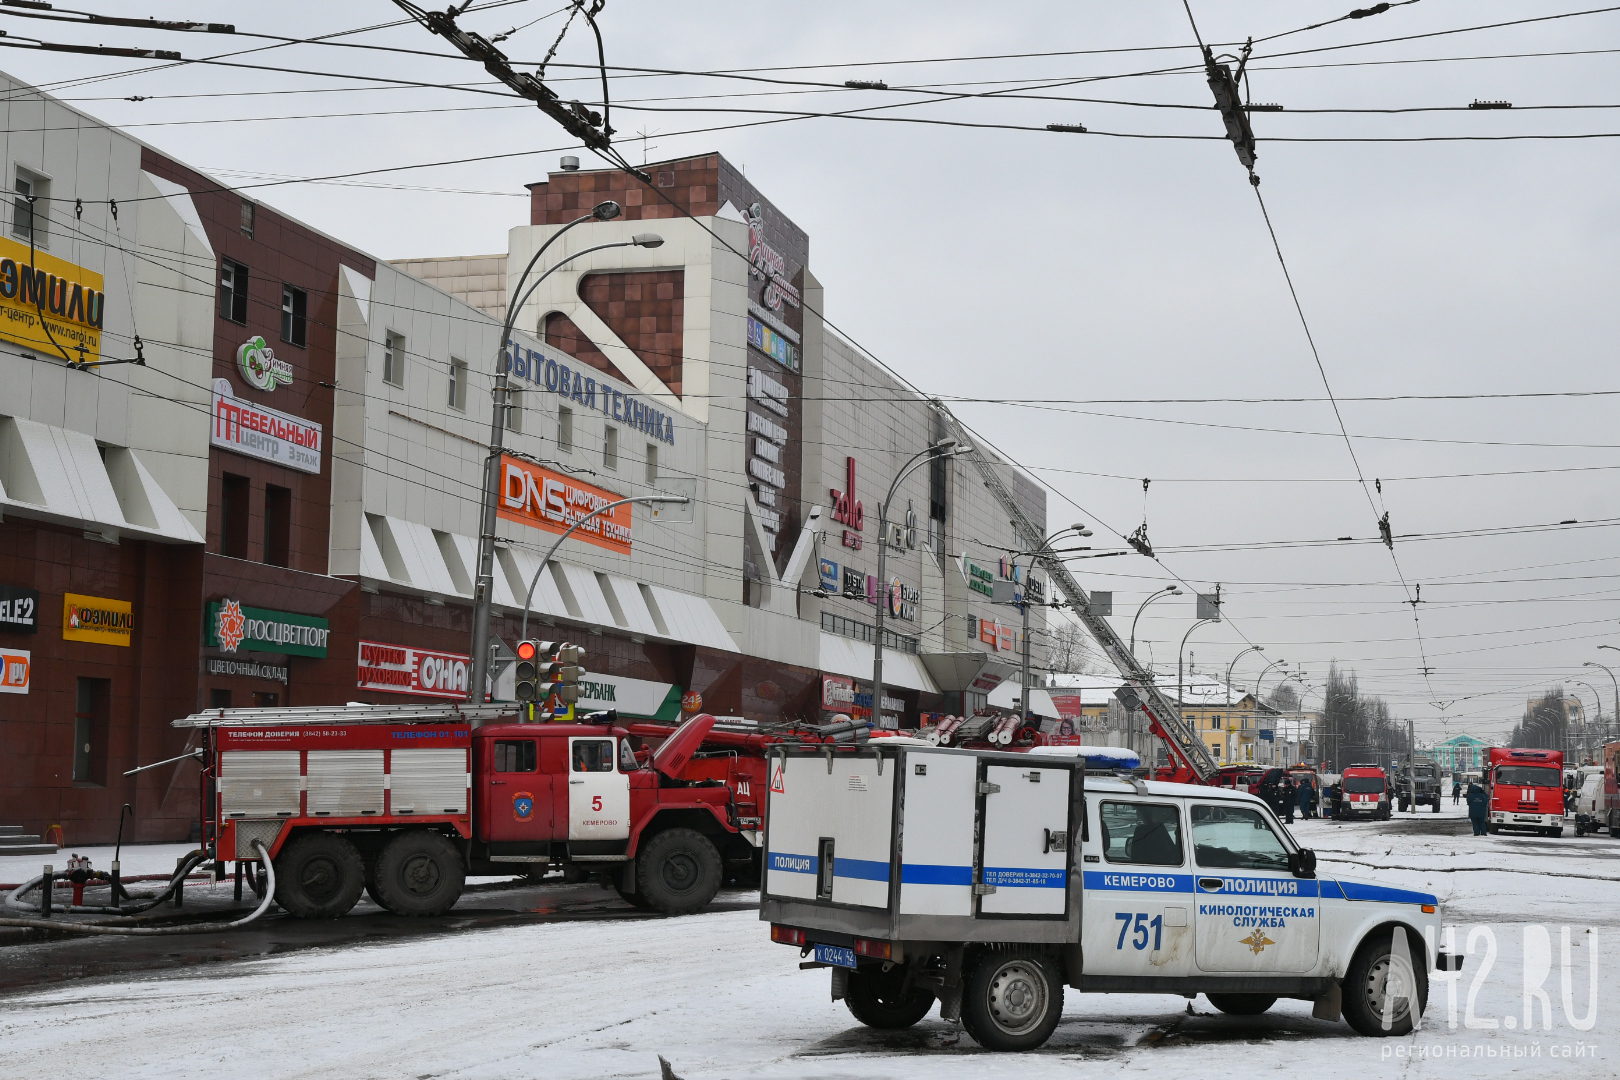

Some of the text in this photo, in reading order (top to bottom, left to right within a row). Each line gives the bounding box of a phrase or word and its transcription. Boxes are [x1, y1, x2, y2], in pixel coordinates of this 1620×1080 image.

[602, 383, 675, 446] ТЕХНИКА
[502, 463, 566, 522] DNS
[829, 456, 864, 531] zolla
[602, 520, 633, 545] ТЕХНИКА
[247, 619, 331, 648] РОСЦВЕТТОРГ
[209, 659, 288, 686] ЦВЕТОЧНЫЙ СКЛАД
[357, 666, 412, 687] ПУХОВИКИ
[682, 695, 695, 704] 24
[391, 731, 437, 739] ТЕЛЕФОН
[454, 730, 469, 738] 101
[737, 781, 751, 797] АЦ
[591, 795, 603, 812] 5
[774, 856, 811, 872] ПОЛИЦИЯ
[1104, 875, 1298, 896] КЕМЕРОВО ПОЛИЦИЯ
[1199, 904, 1315, 918] КИНОЛОГИЧЕСКАЯ
[1115, 912, 1163, 951] 751
[1233, 917, 1286, 928] СЛУЖБА
[845, 950, 854, 962] 42
